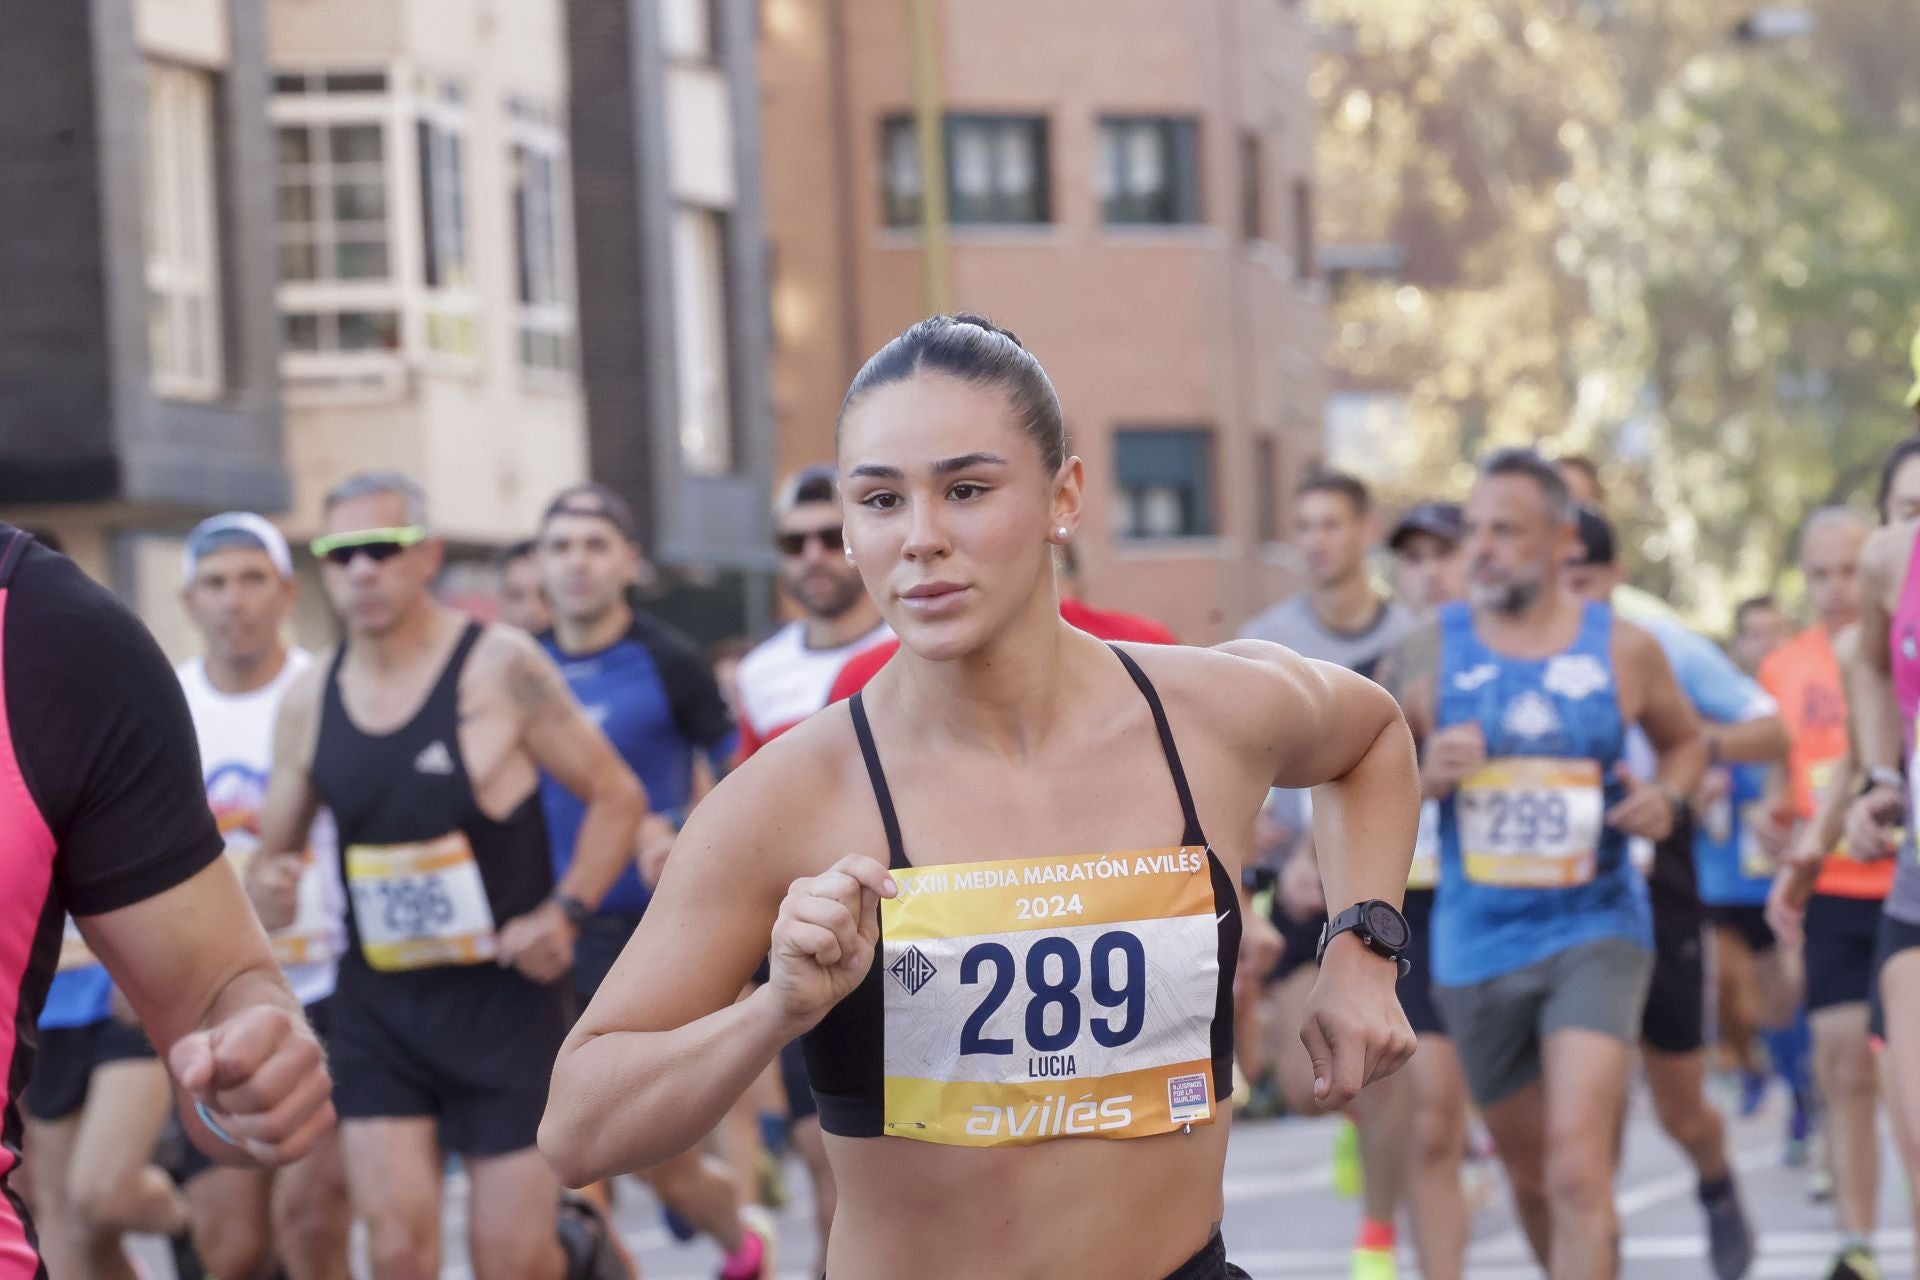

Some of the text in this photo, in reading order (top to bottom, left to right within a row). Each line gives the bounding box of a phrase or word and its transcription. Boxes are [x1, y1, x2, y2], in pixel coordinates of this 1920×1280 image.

[1488, 791, 1568, 845] 299
[954, 868, 1020, 891] MEDIA
[1024, 855, 1129, 885] MARATÓN
[1134, 848, 1201, 876] AVILÉS
[1015, 893, 1083, 921] 2024
[960, 931, 1146, 1056] 289
[1028, 1055, 1077, 1078] LUCIA
[965, 1093, 1133, 1137] avilés
